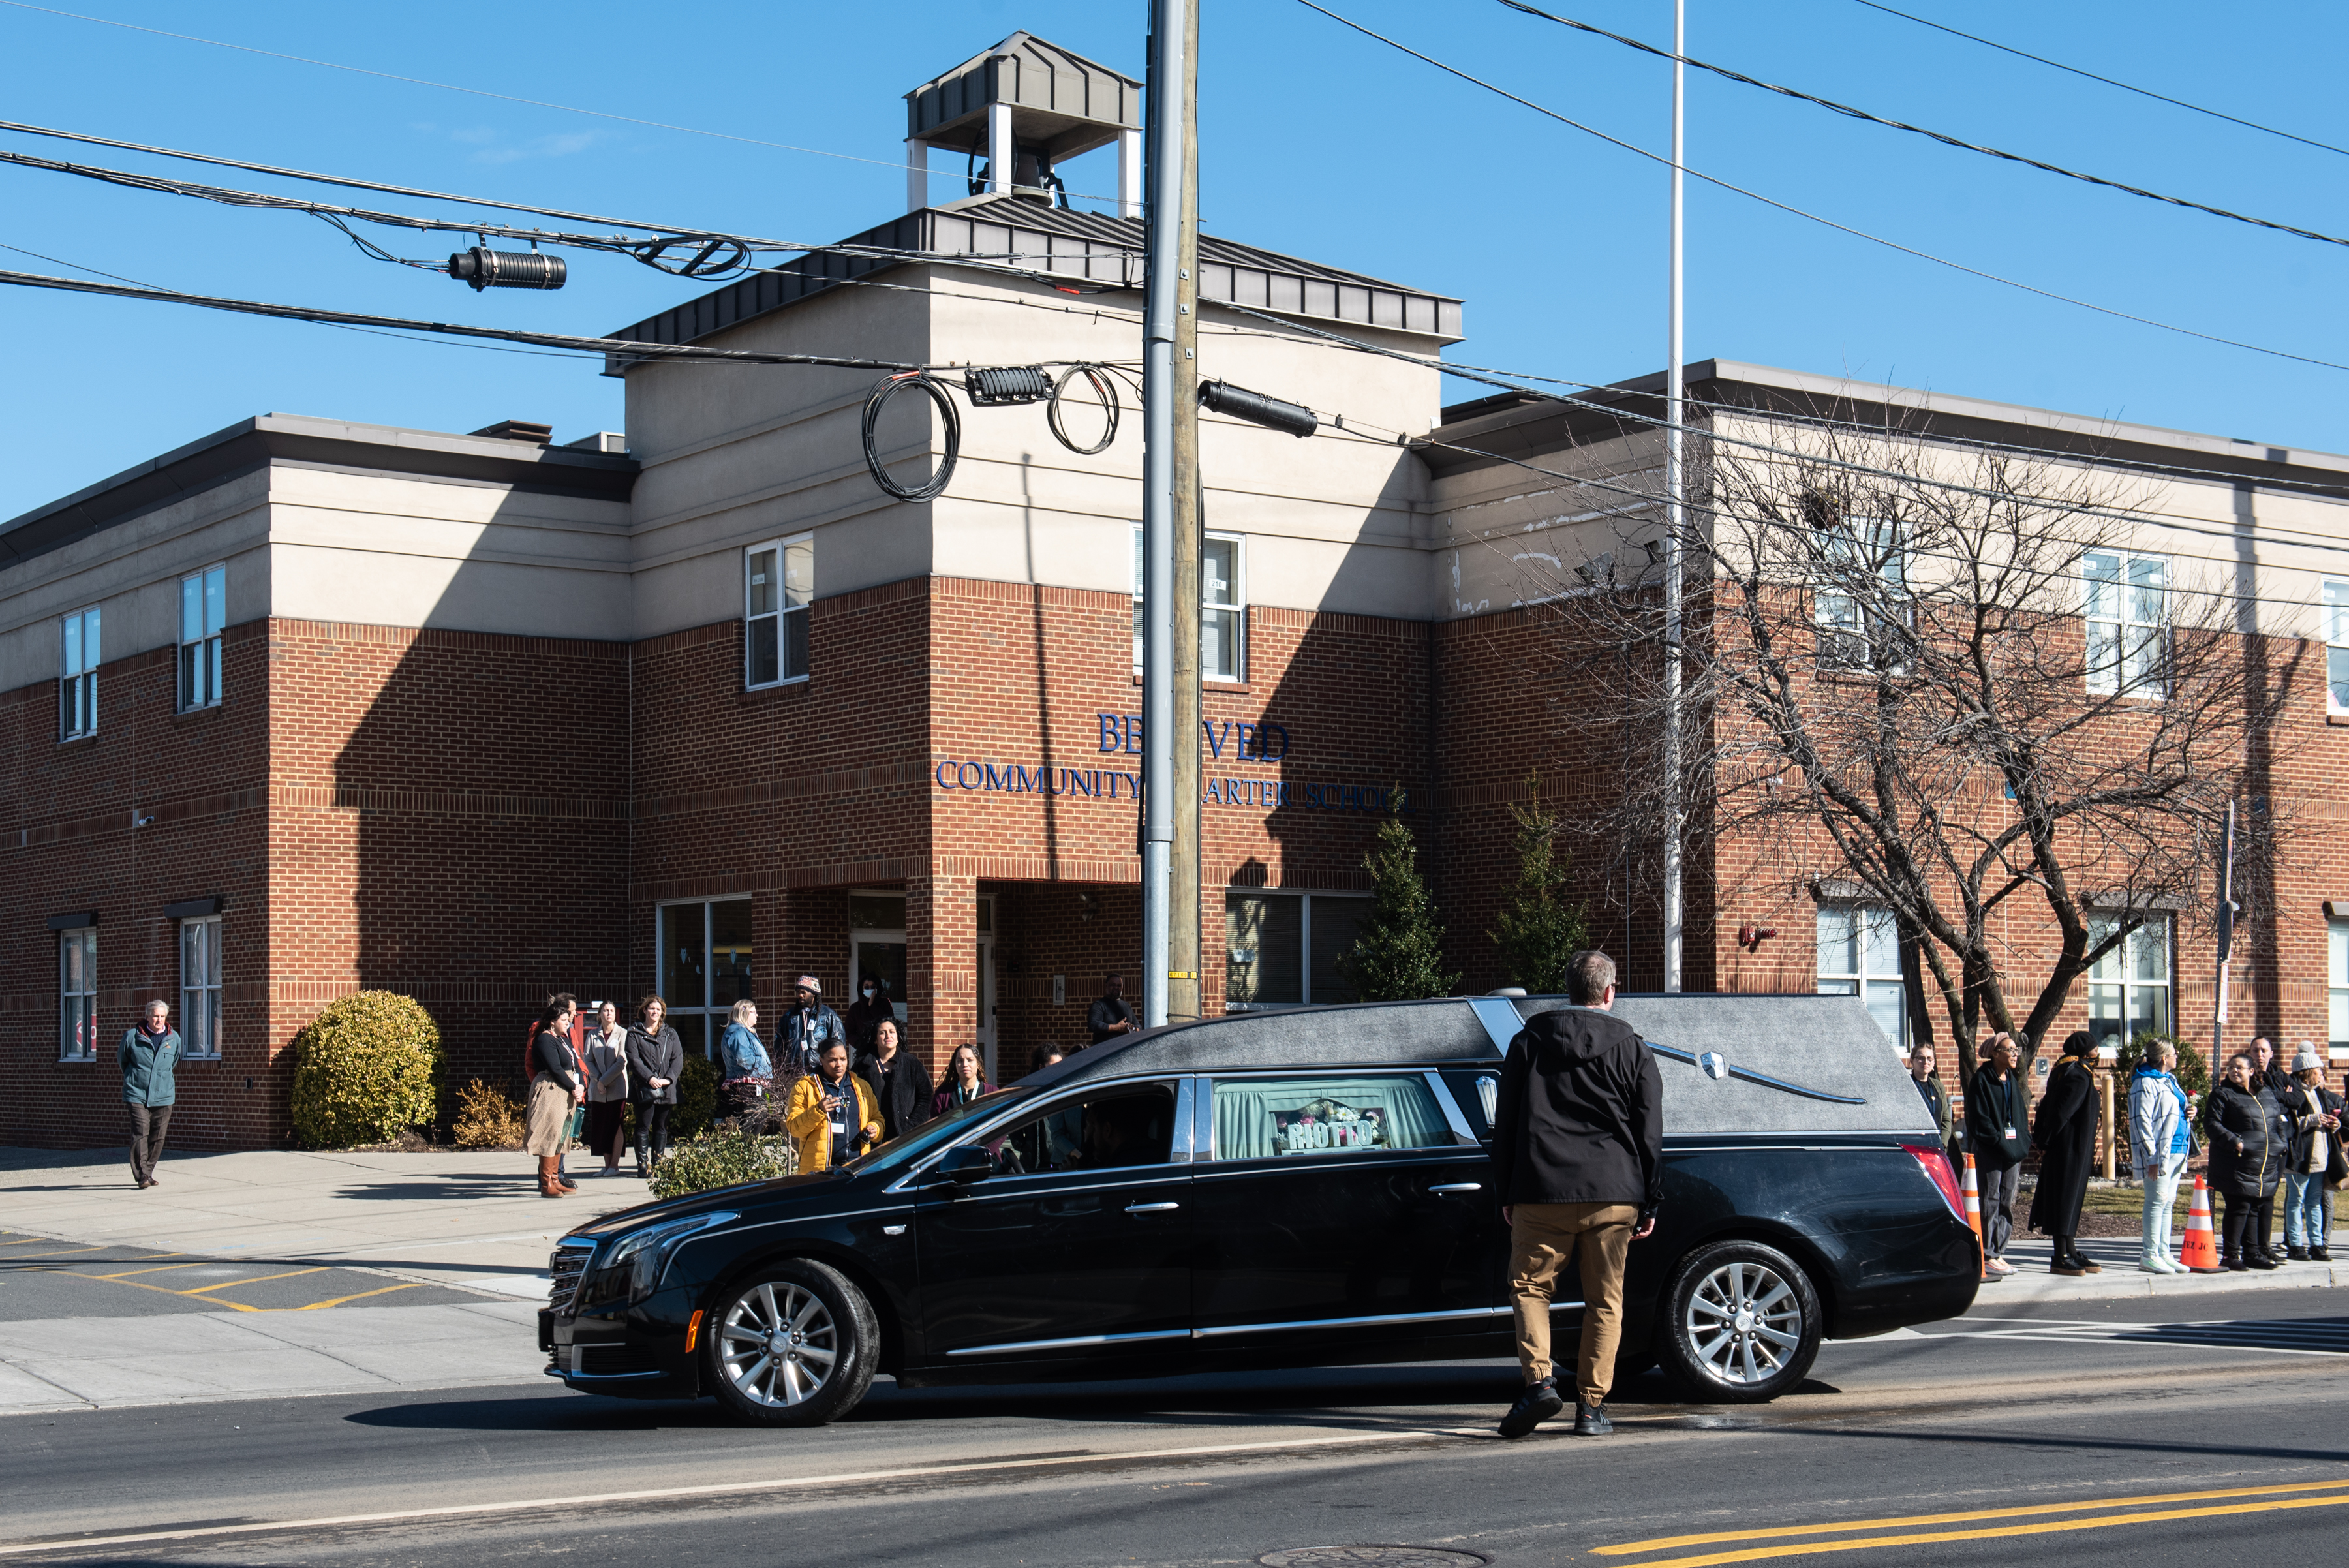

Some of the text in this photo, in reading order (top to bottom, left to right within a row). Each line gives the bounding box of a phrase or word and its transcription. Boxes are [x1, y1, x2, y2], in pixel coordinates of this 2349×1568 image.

[1098, 713, 1289, 762] BEVED
[936, 761, 1141, 798] COMMUNITY
[1288, 1120, 1372, 1150] RIOTTO
